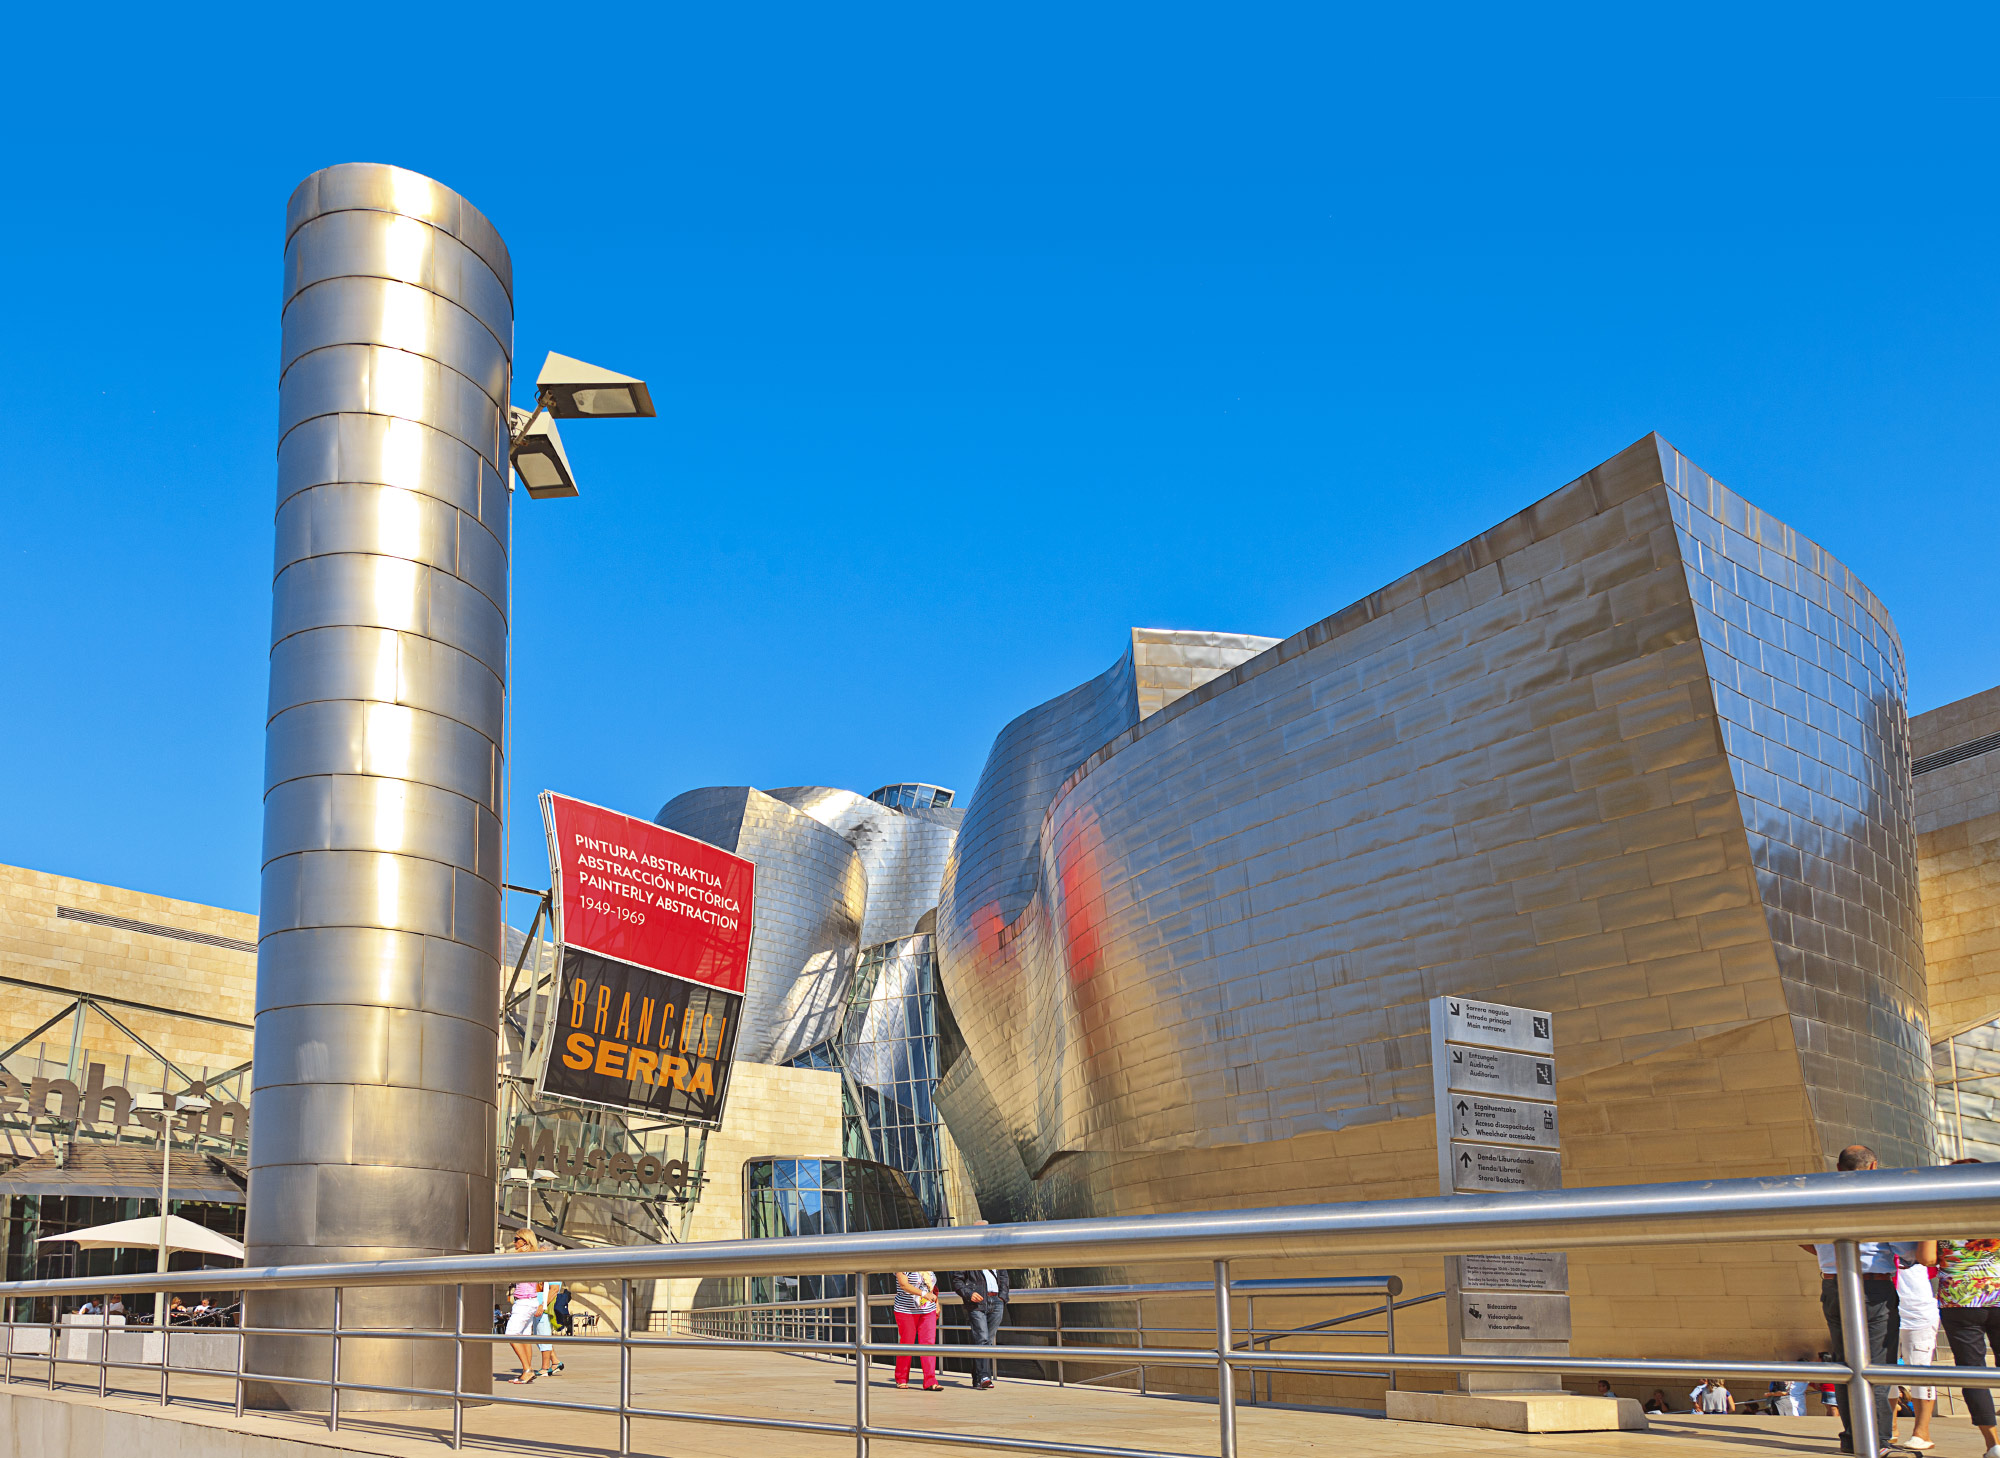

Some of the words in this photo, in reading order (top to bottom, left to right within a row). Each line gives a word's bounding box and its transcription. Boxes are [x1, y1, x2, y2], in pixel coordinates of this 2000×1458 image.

[575, 834, 639, 863] PINTURA
[640, 853, 723, 890] ABSTRAKTUA
[577, 853, 675, 893] ABSTRACCIÓN
[677, 881, 741, 914] PICTÓRICA
[579, 871, 654, 905] PAINTERLY
[655, 895, 739, 932] ABSTRACTION
[580, 895, 646, 926] 1949-1969
[1466, 1004, 1487, 1014] Sarrera
[1488, 1009, 1510, 1017] nagusia
[570, 977, 727, 1062] BRANCUSI
[1466, 1013, 1488, 1022] Entrada
[1489, 1017, 1512, 1026] principal
[1467, 1022, 1481, 1030] Main
[1482, 1025, 1506, 1033] entrance
[562, 1032, 715, 1096] SERRA
[1469, 1061, 1495, 1070] Auditorio
[1469, 1070, 1500, 1079] Auditorium
[1474, 1111, 1496, 1119] sarrera
[1475, 1120, 1494, 1128] Acceso
[1495, 1121, 1535, 1132] discapacitados
[1475, 1129, 1507, 1138] Wheelchair
[1508, 1132, 1536, 1141] accessible
[508, 1125, 690, 1188] Museoa
[1478, 1174, 1525, 1185] Store/Bookstore
